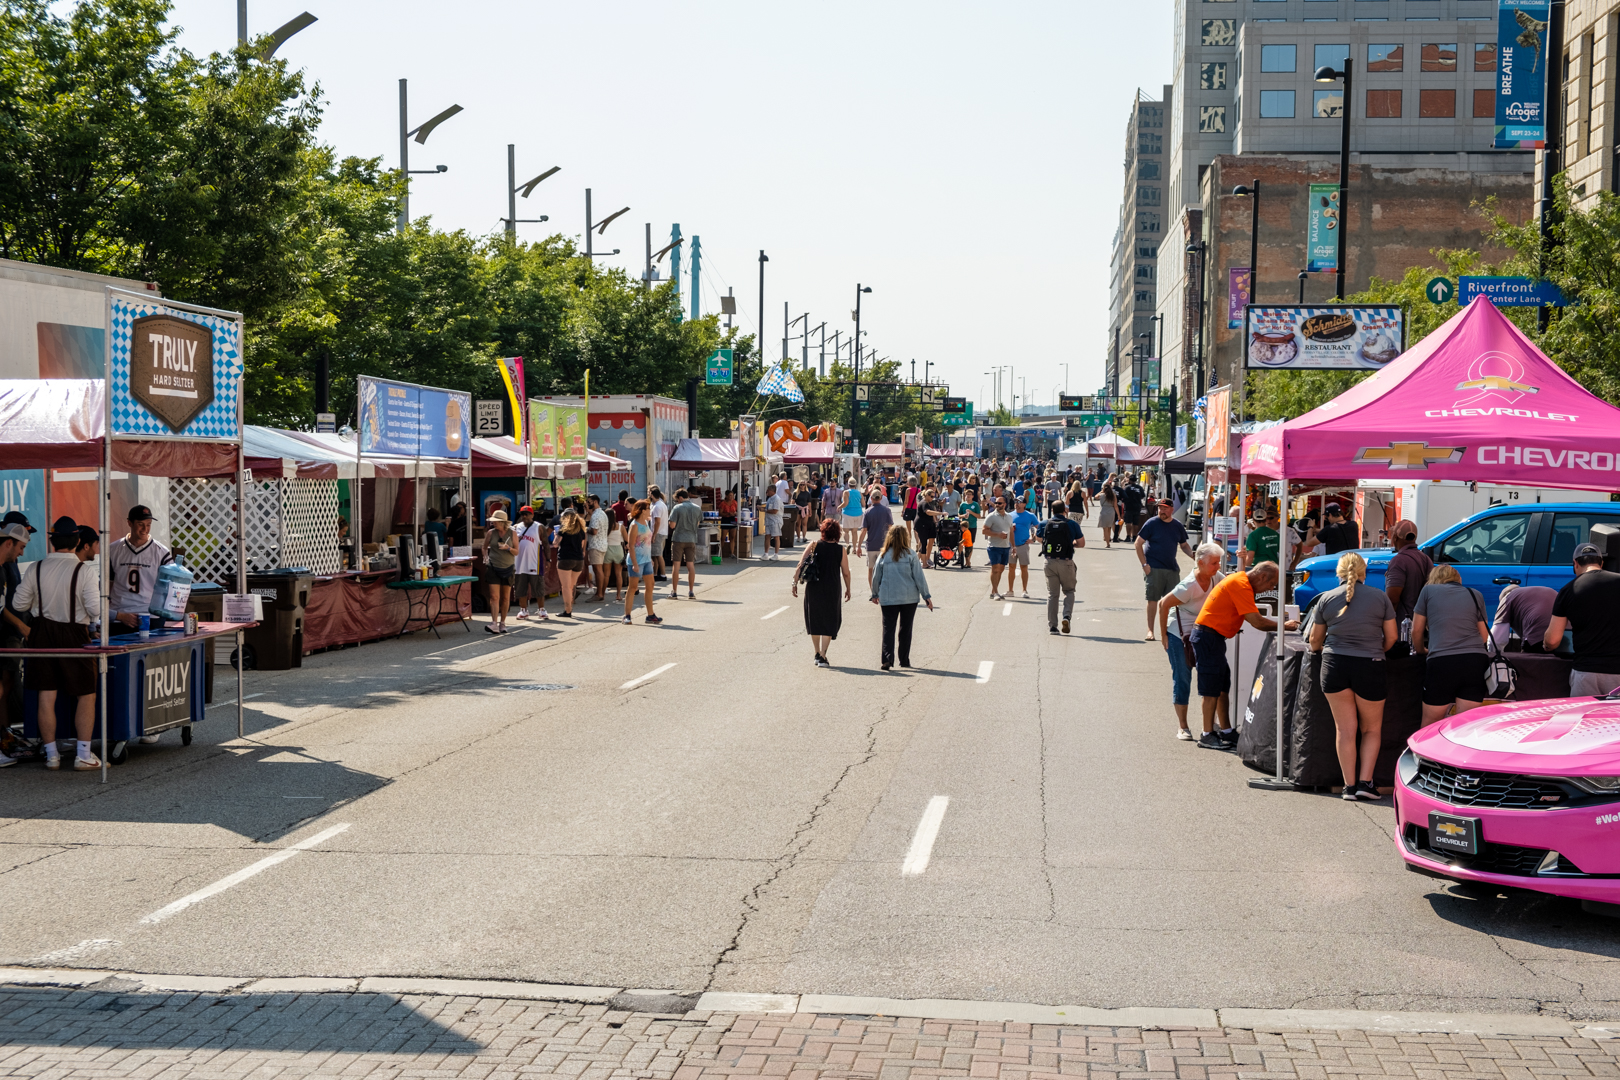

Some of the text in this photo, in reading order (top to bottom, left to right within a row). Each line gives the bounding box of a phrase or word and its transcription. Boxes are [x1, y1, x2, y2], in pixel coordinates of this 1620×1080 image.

[1502, 47, 1513, 95] BREATHE
[1506, 102, 1540, 122] Kroger
[1314, 246, 1335, 257] Kroger
[1468, 282, 1534, 293] Riverfront
[1489, 295, 1517, 303] Center
[1520, 295, 1541, 303] Lane
[1303, 311, 1353, 341] Schmidt's
[149, 333, 198, 373] TRULY
[153, 374, 195, 389] HARD SELTZER
[1425, 408, 1579, 422] CHEVROLET
[479, 418, 499, 430] 25
[588, 473, 635, 484] AM TRUCK
[1270, 482, 1280, 495] 223
[1508, 491, 1519, 500] T3
[128, 569, 140, 594] 9
[146, 661, 190, 701] TRULY
[173, 697, 186, 707] Seltzer
[1436, 836, 1468, 847] CHEVROLET
